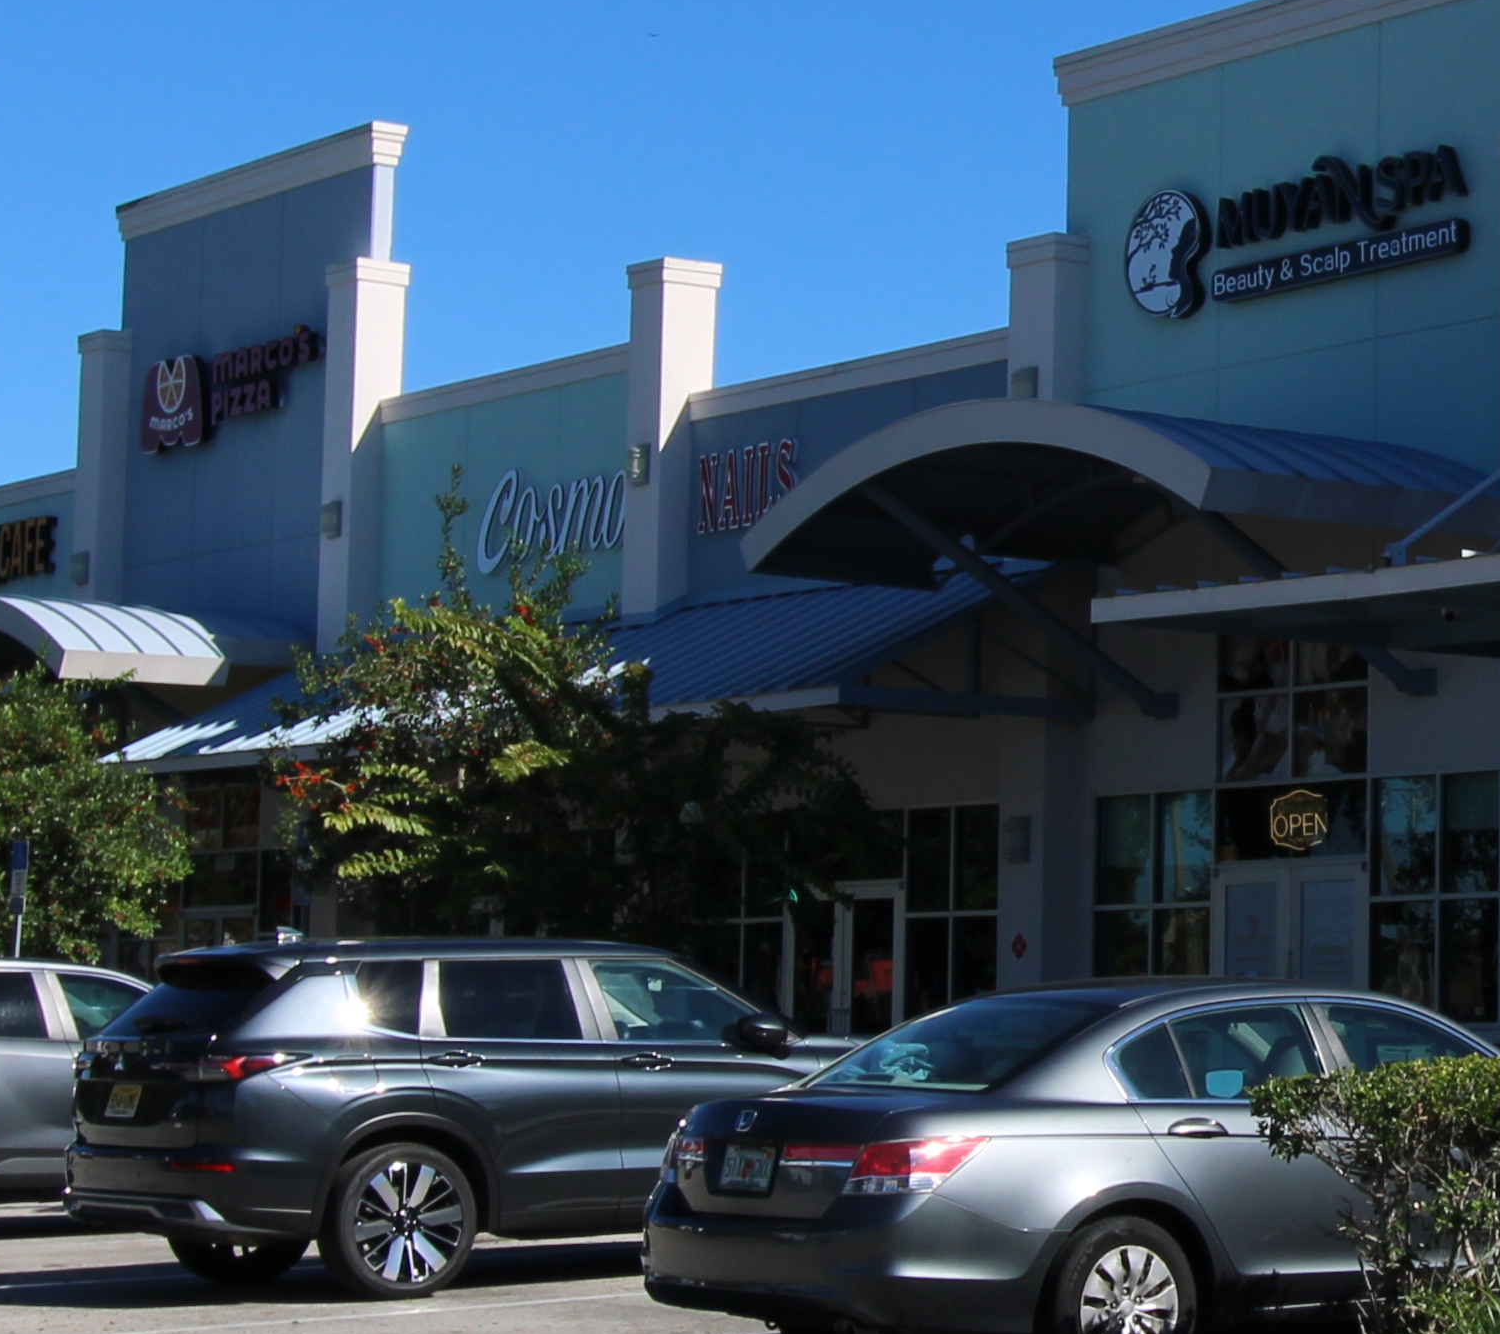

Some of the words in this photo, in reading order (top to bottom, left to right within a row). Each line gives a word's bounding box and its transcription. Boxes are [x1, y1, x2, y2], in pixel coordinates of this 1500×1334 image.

[1216, 155, 1393, 249] MUYAN
[1372, 144, 1469, 212] SPA
[1213, 264, 1275, 296] Beauty
[1279, 258, 1295, 281] &
[1300, 246, 1351, 274] Scalp
[1357, 220, 1458, 264] Treatment
[212, 324, 314, 385] MARCO'S
[149, 407, 194, 431] MARCO'S
[211, 379, 272, 425] PIZZA
[697, 438, 798, 535] NAILS
[476, 468, 626, 576] Cosmo
[1273, 812, 1328, 838] OPEN
